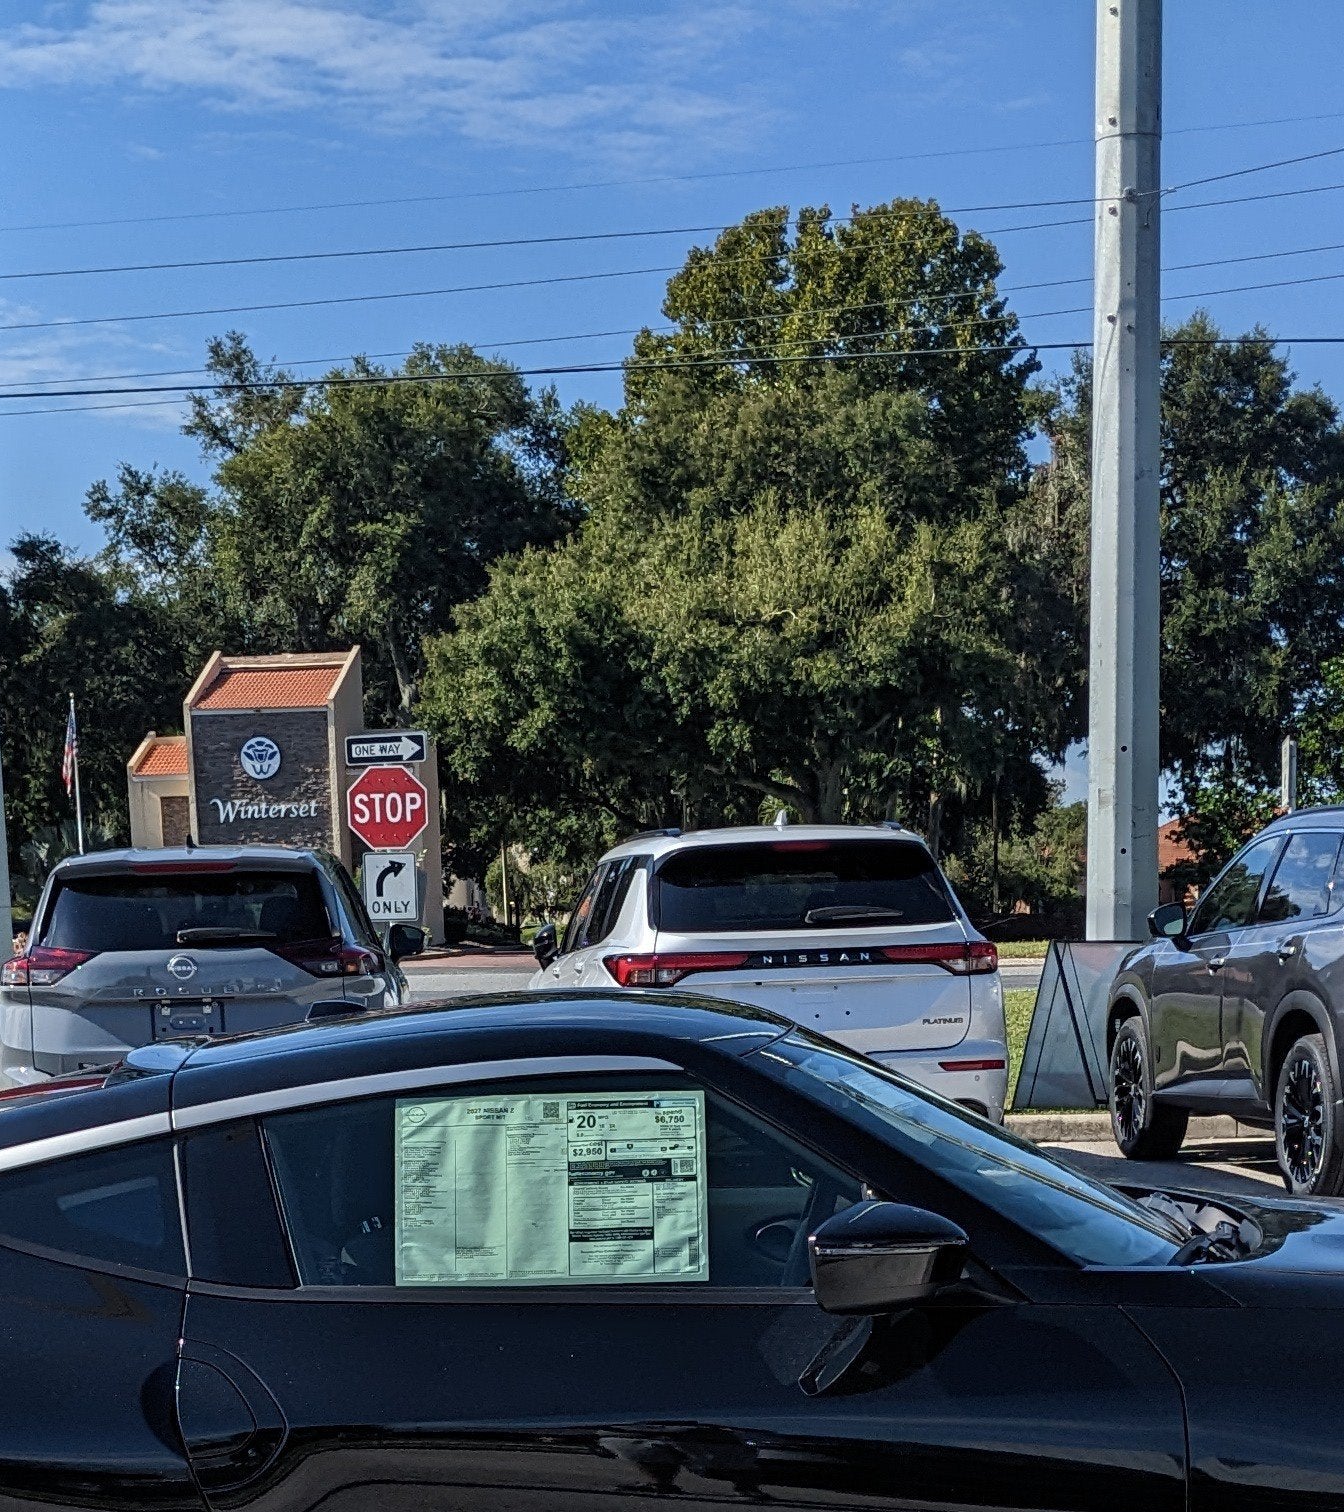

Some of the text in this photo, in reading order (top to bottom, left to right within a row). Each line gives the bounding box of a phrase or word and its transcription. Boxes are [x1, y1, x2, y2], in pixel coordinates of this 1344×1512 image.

[354, 743, 401, 756] ONE WAY
[209, 798, 319, 824] Winterset
[354, 792, 422, 824] STOP
[372, 900, 411, 914] ONLY
[762, 952, 870, 964] NISSAN
[576, 1114, 596, 1129] 20
[654, 1115, 685, 1124] $6,750
[572, 1147, 603, 1157] $2,950
